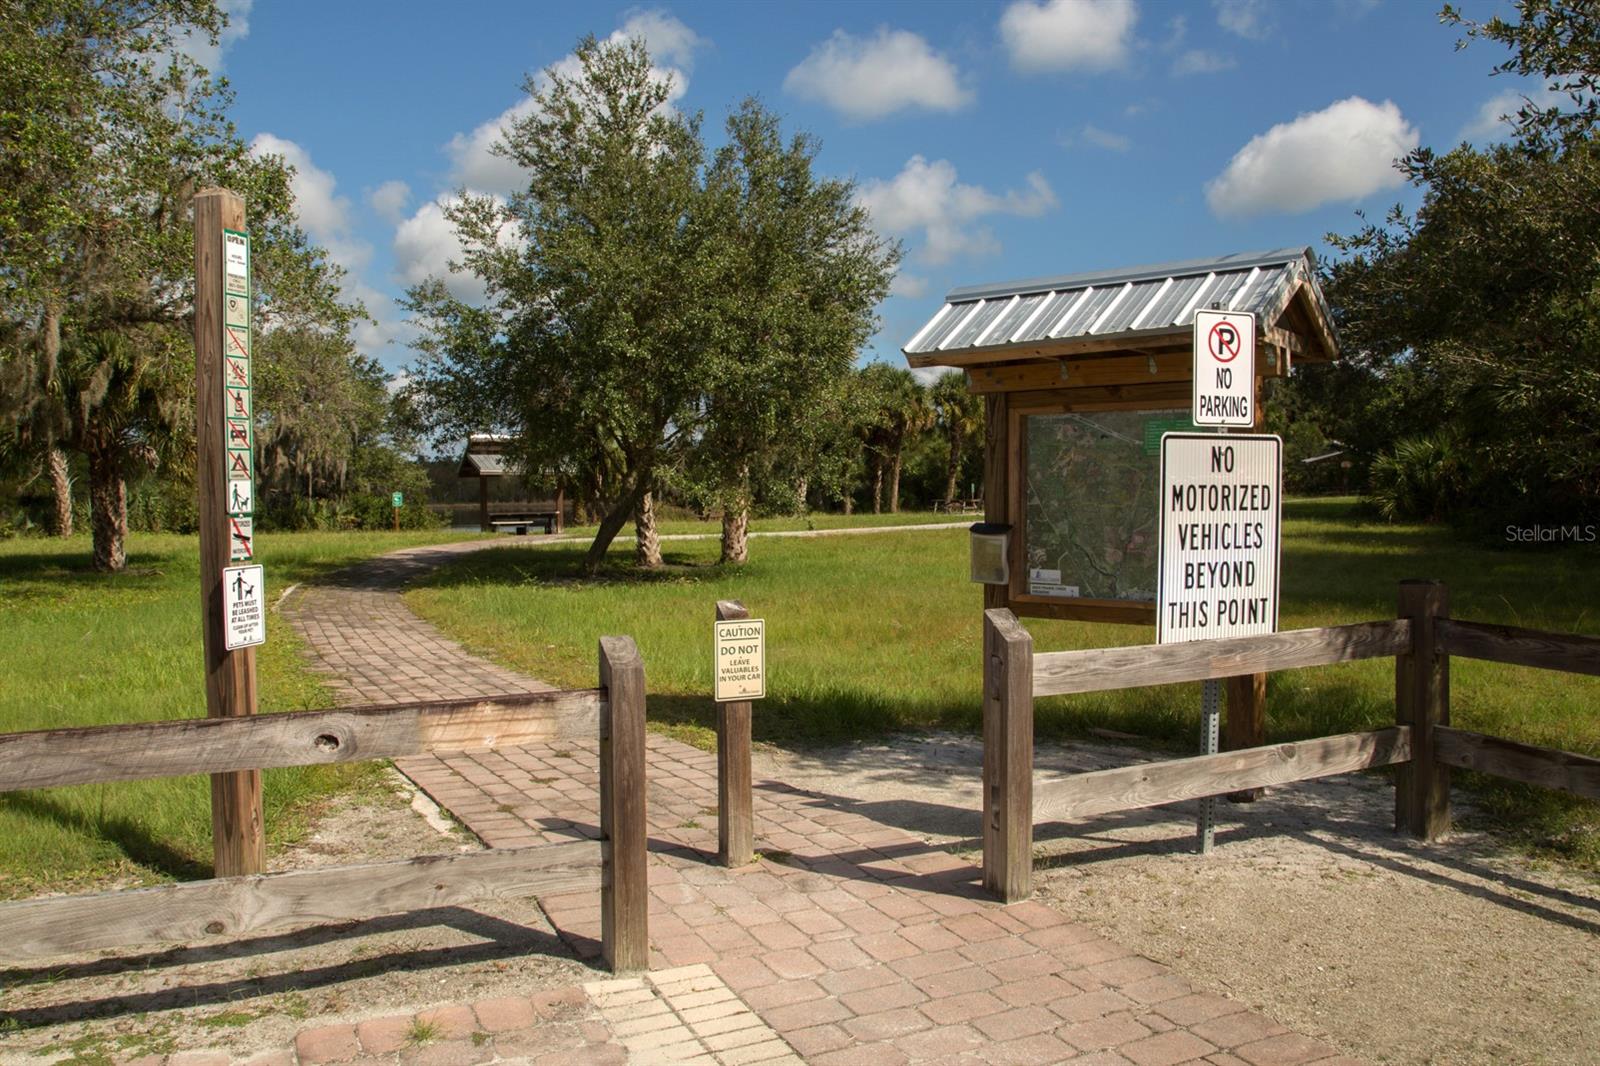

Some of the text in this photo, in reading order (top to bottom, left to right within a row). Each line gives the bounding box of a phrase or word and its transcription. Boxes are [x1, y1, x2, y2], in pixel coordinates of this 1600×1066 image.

[227, 235, 245, 246] OPEN
[1216, 368, 1232, 389] NO
[1200, 395, 1248, 418] PARKING
[1212, 446, 1234, 472] NO
[1172, 484, 1270, 512] MOTORIZED
[1178, 522, 1263, 550] VEHICLES
[1184, 560, 1255, 589] BEYOND
[239, 607, 258, 615] LEASHED
[1168, 598, 1268, 629] THIS POINT
[719, 626, 760, 638] CAUTION
[720, 645, 758, 656] DO NOT
[721, 666, 759, 674] VALUABLES
